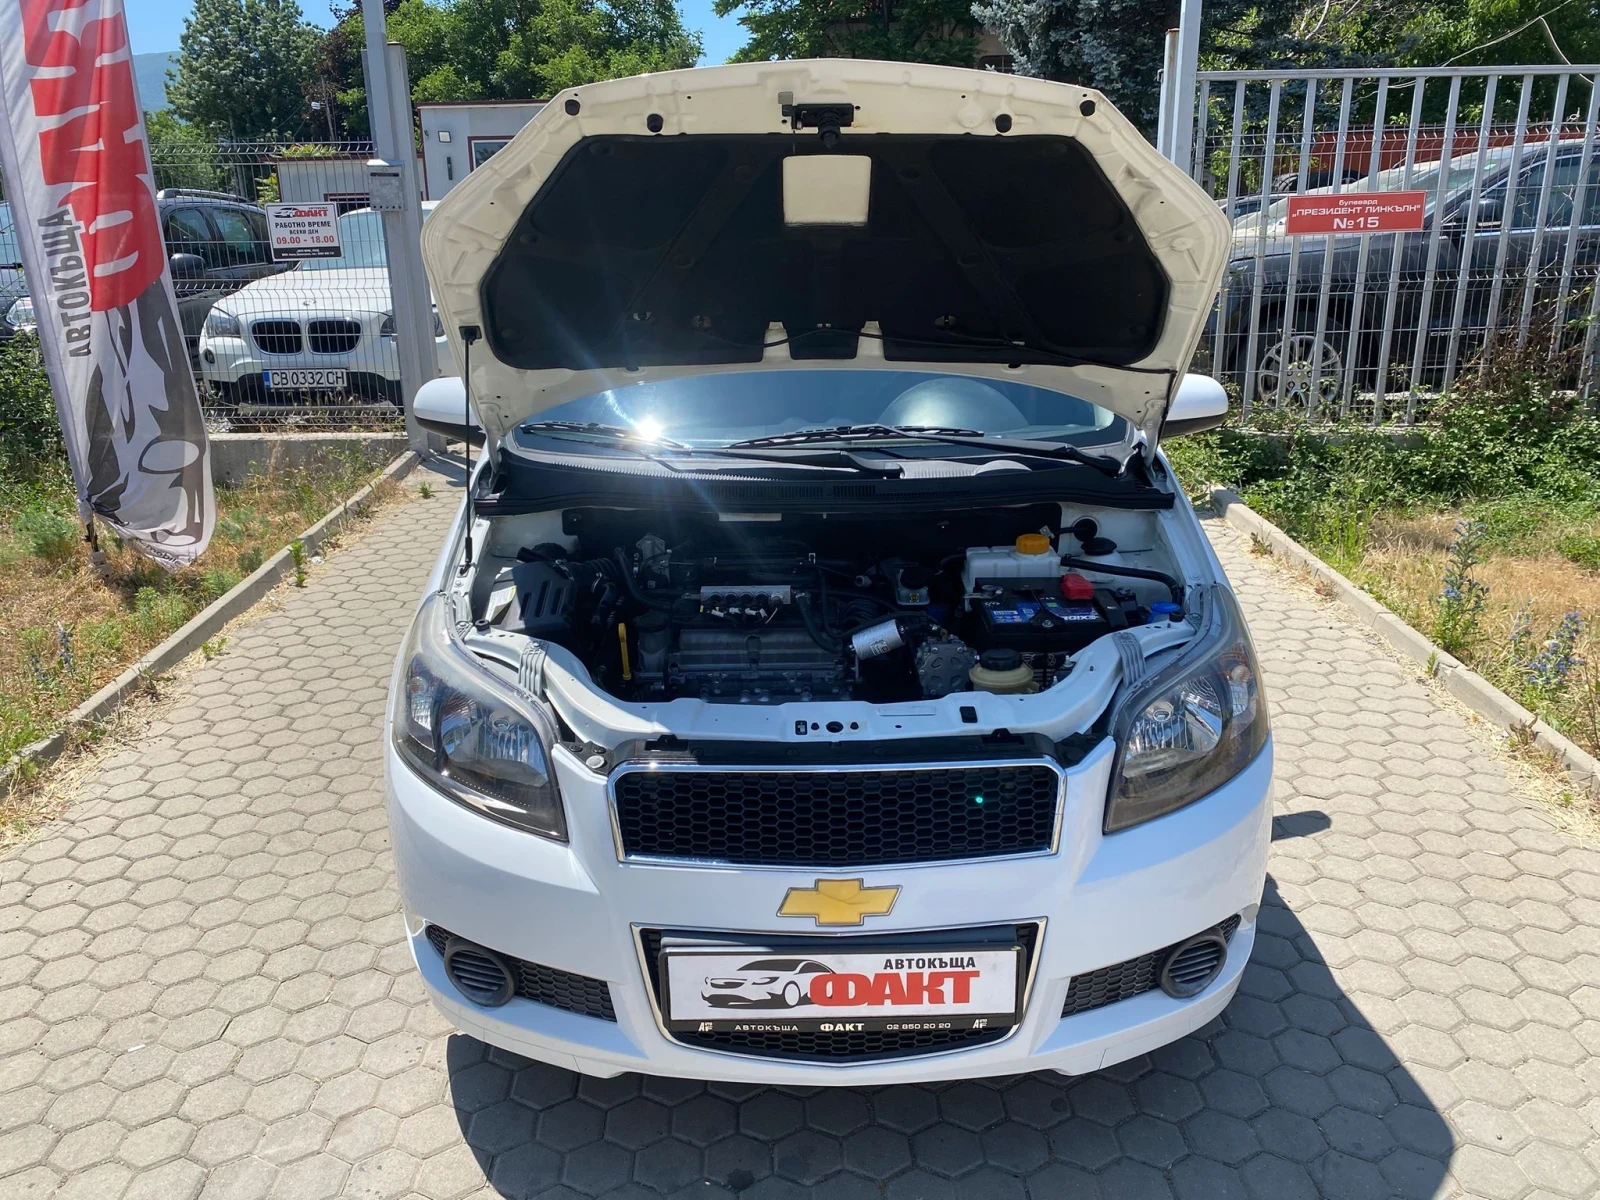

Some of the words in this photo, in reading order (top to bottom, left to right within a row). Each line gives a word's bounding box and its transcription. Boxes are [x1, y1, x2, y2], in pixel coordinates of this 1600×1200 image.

[19, 0, 164, 312] ФАК
[276, 236, 301, 244] 09.00
[310, 235, 335, 244] 18.00
[37, 204, 92, 358] АВТОКЪЩА
[883, 957, 976, 970] АВТОКЪЩА
[809, 970, 980, 1006] ФАКТ
[820, 1023, 865, 1031] ФАКТ
[901, 1022, 921, 1030] 850
[938, 1021, 951, 1029] 20
